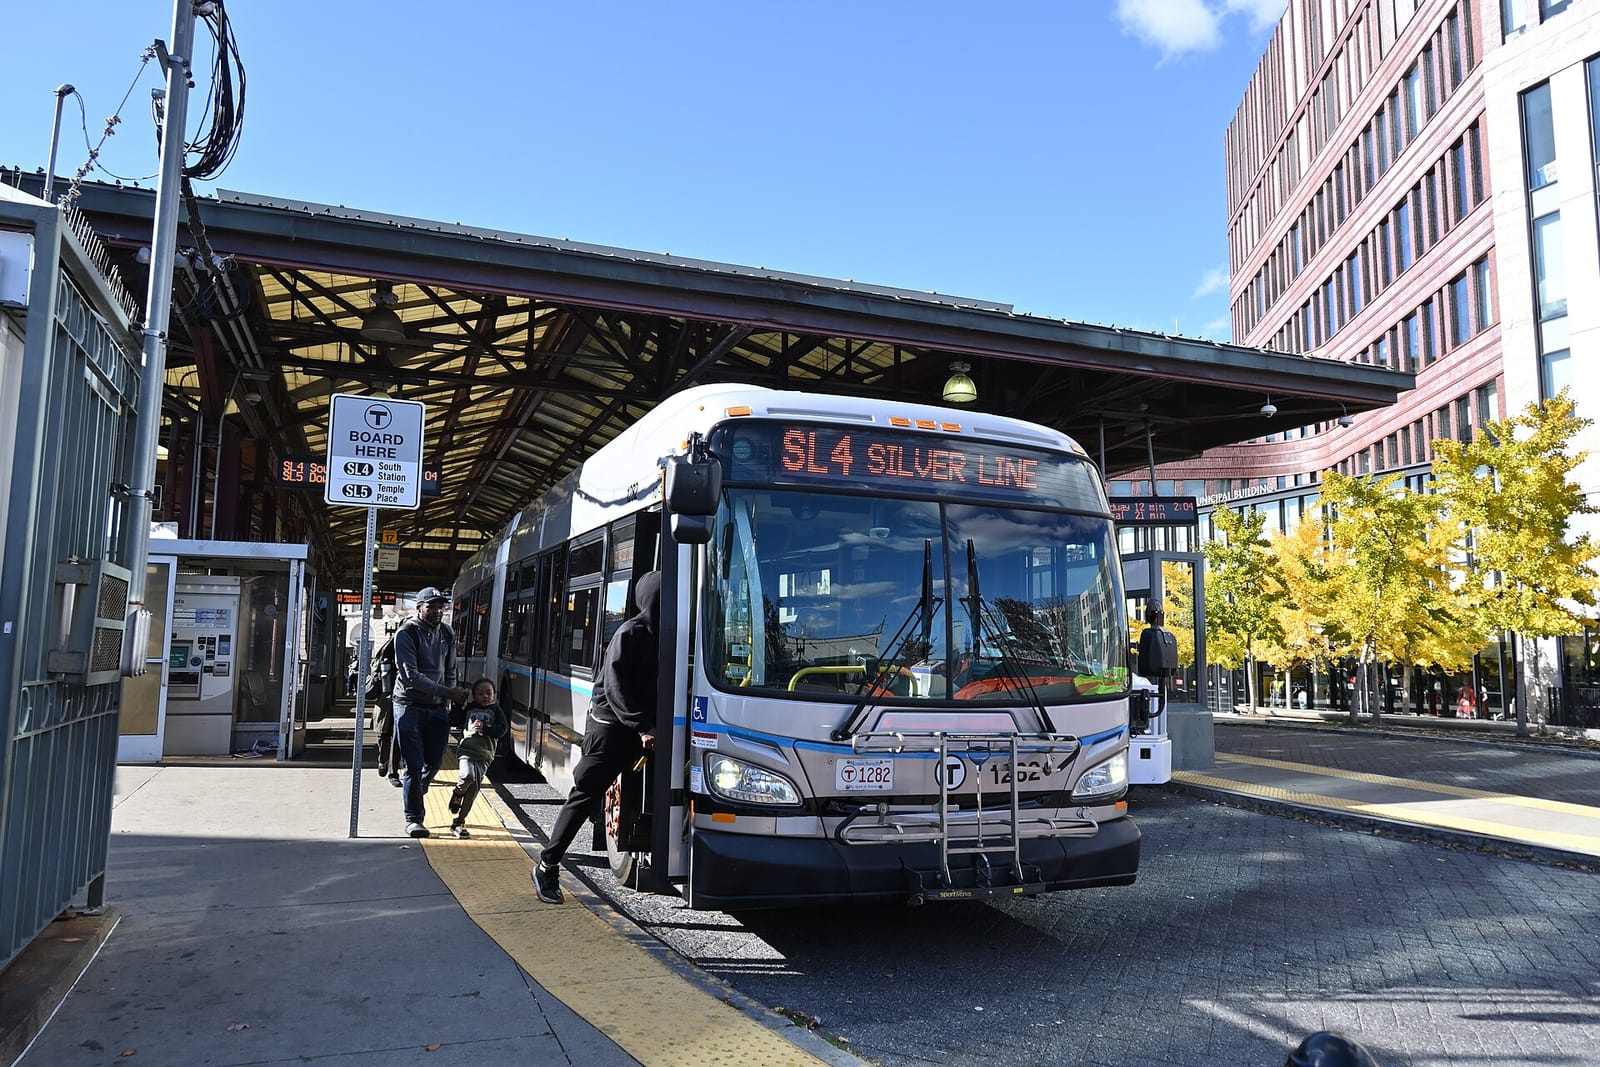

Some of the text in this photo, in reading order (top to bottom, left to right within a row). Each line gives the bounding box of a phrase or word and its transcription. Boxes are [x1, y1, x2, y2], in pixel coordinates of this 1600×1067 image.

[349, 430, 404, 446] BOARD
[355, 444, 397, 459] HERE
[782, 428, 1038, 489] SL4 SILVER LINE
[282, 460, 304, 473] SL4
[346, 461, 402, 476] SL4 South
[281, 471, 304, 482] SL5
[377, 472, 406, 482] Station
[345, 483, 405, 498] SL5 Temple
[1234, 484, 1276, 499] BUILDING
[376, 493, 398, 503] Place
[1134, 503, 1145, 512] 12
[1149, 503, 1165, 512] min
[1173, 502, 1194, 512] 2:04
[1135, 511, 1145, 520] 21
[1150, 512, 1166, 520] min
[385, 534, 395, 542] 17
[858, 766, 891, 783] 1282
